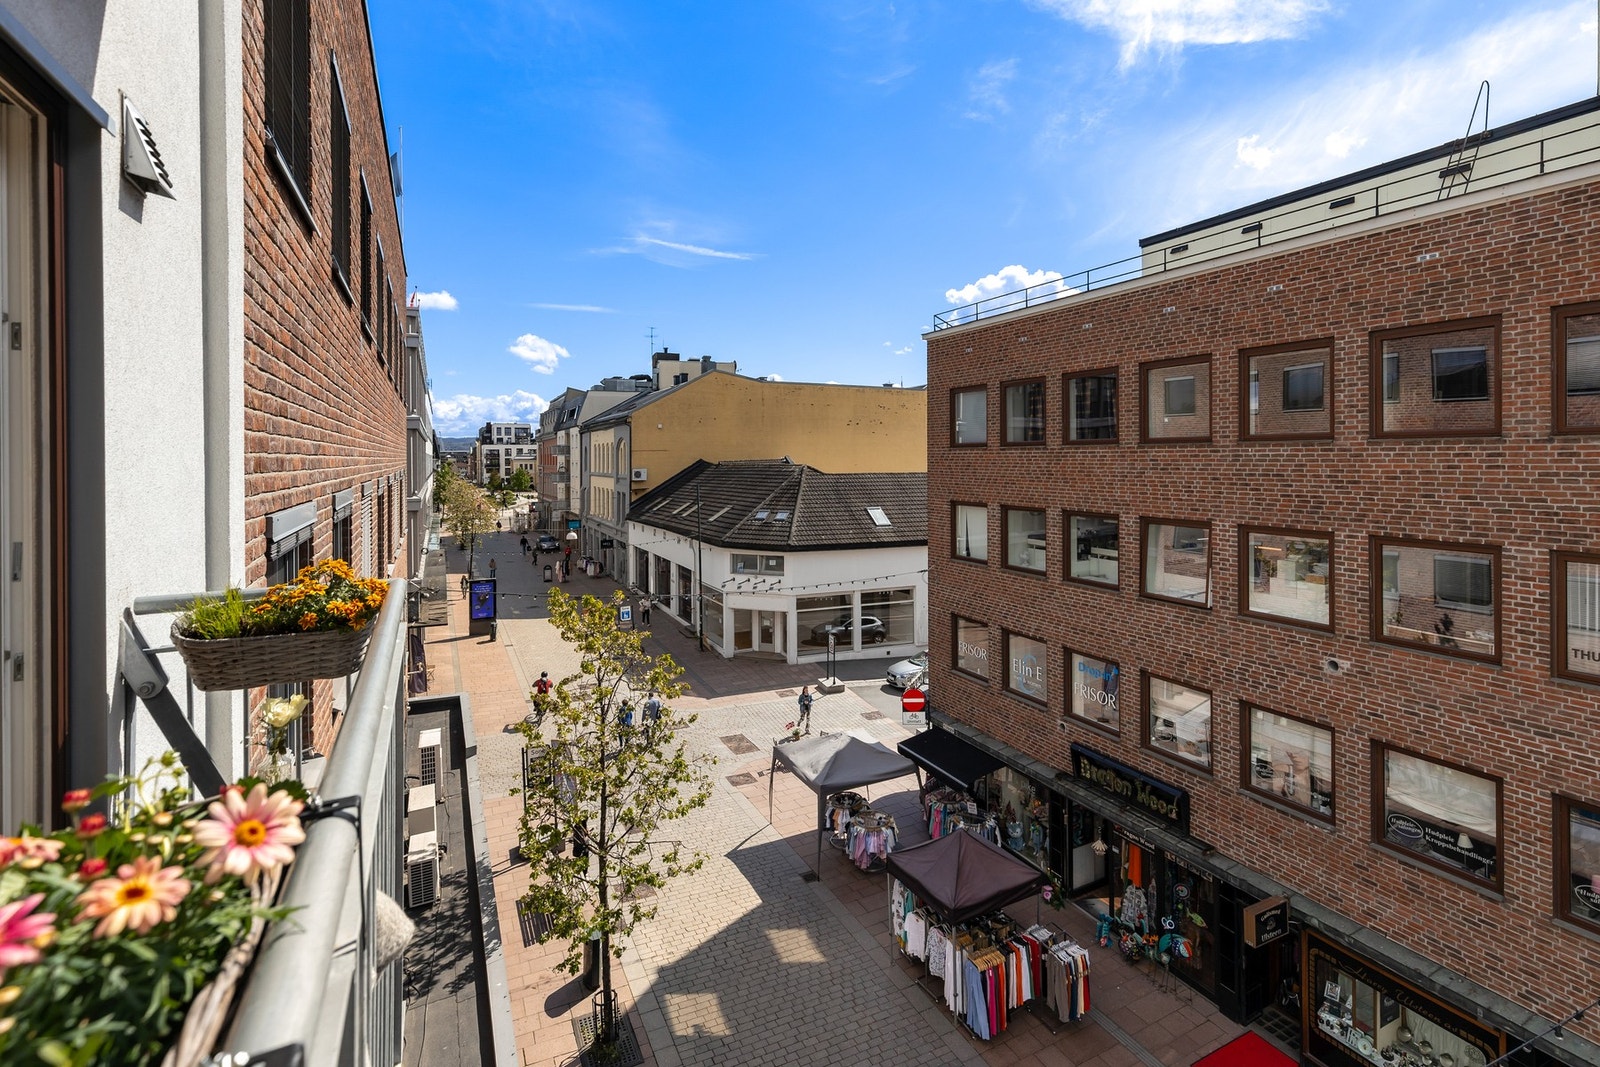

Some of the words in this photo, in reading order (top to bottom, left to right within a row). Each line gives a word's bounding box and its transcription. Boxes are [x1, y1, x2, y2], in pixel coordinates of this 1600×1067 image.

[958, 641, 987, 661] FRISØR
[1571, 648, 1600, 662] THU
[1013, 658, 1032, 676] Elin
[1074, 682, 1116, 709] FRISØR
